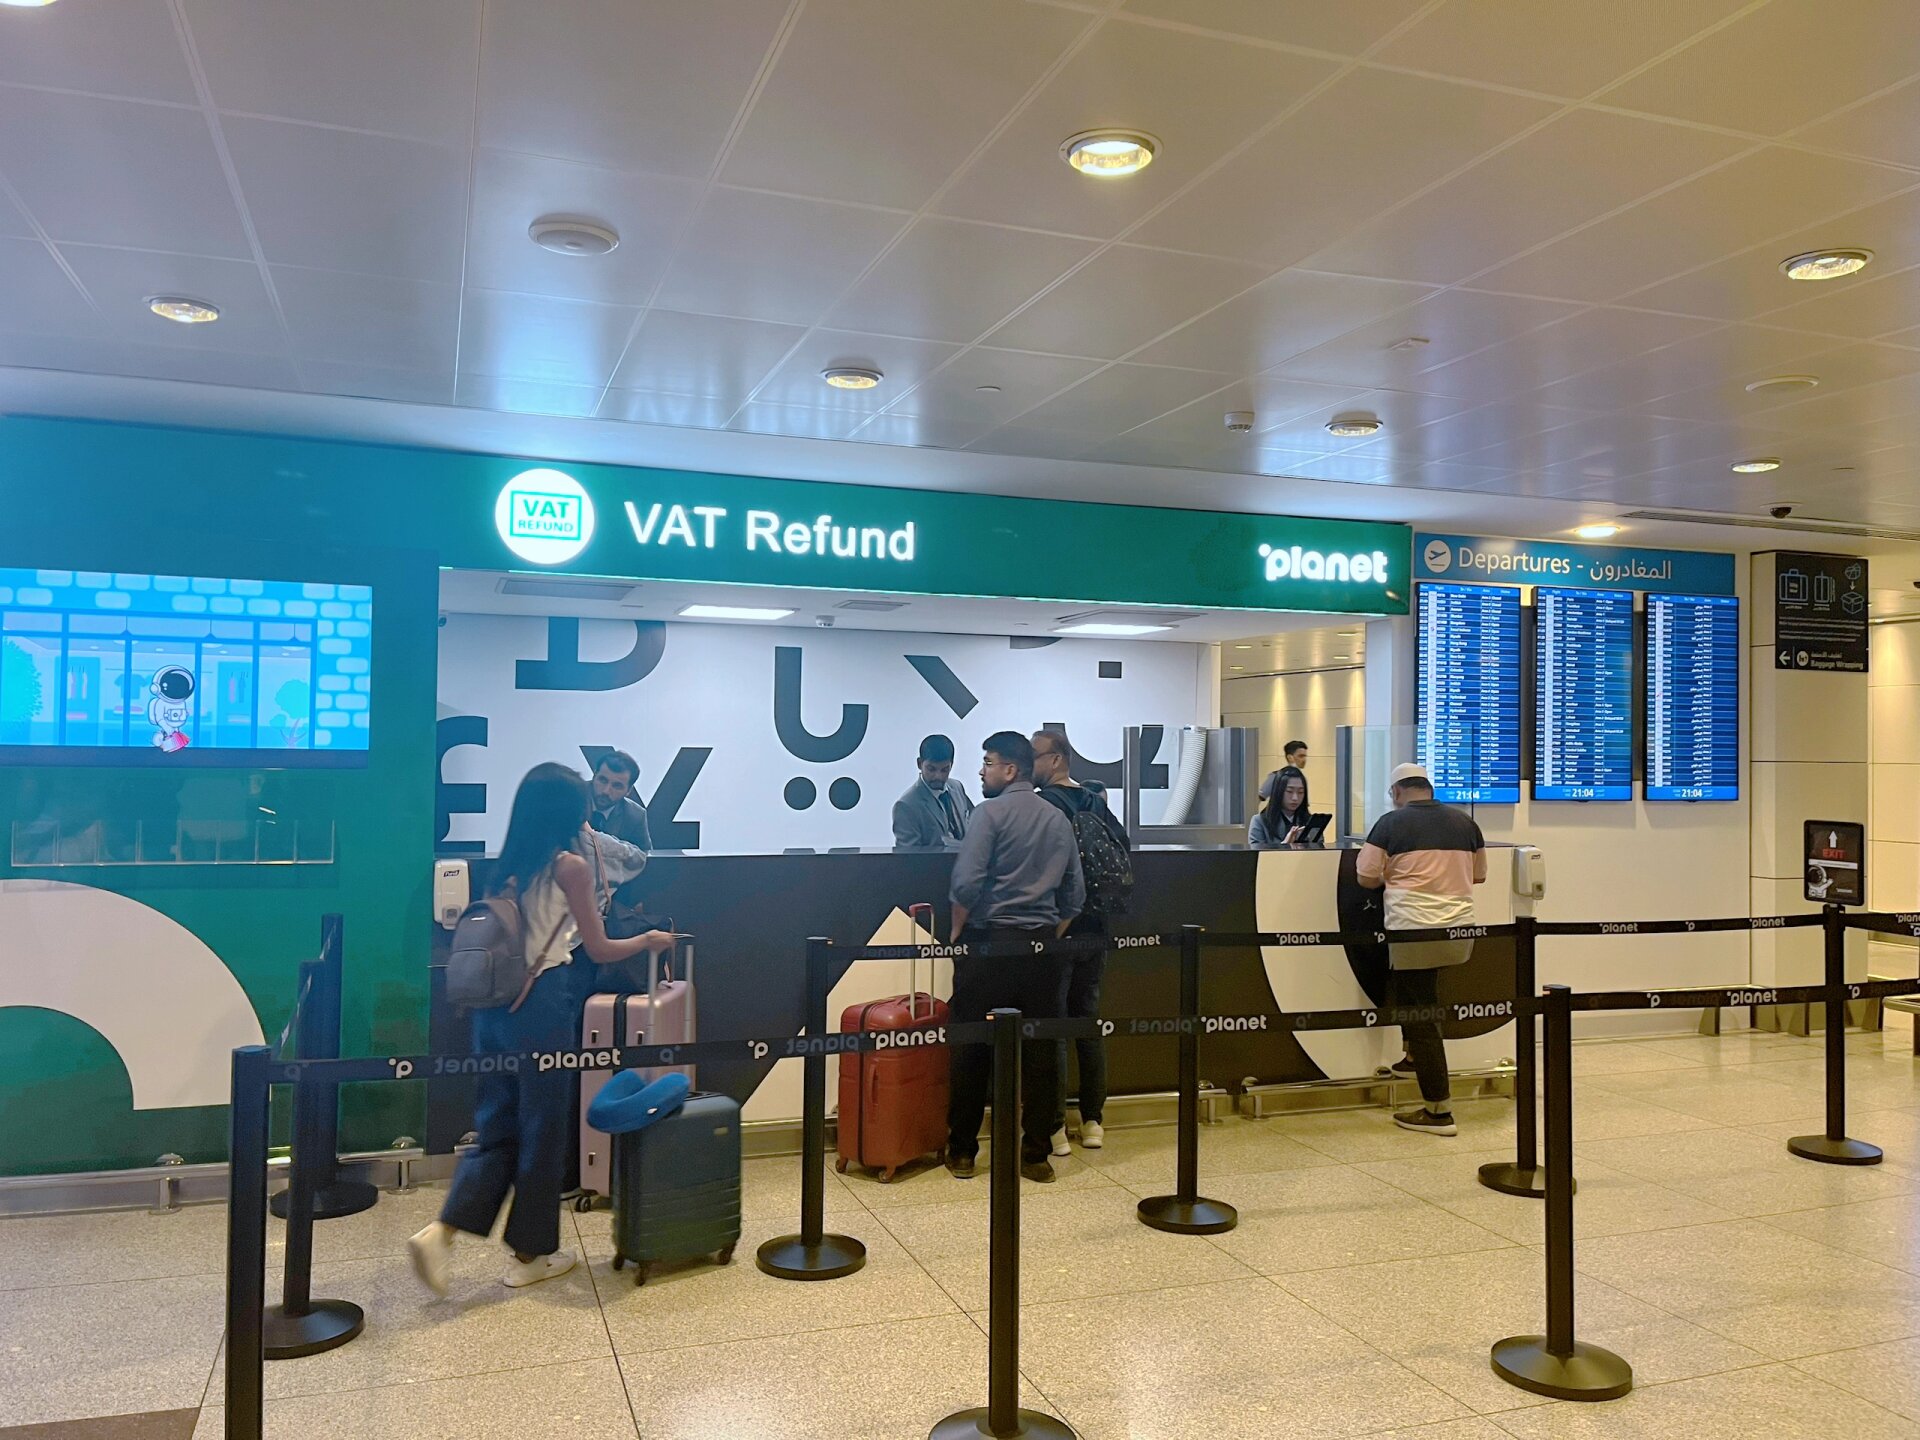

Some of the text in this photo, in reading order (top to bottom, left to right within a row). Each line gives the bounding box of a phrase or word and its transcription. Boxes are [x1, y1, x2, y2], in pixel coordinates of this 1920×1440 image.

[523, 499, 570, 518] VAT
[518, 519, 574, 532] REFUND
[624, 501, 916, 561] VAT Refund
[1259, 544, 1388, 583] planet
[1459, 547, 1570, 574] Departures
[1590, 558, 1672, 581] المغادرون
[1456, 790, 1480, 800] 21:04
[1572, 788, 1594, 798] 21:04
[1681, 788, 1703, 798] 21:04
[1823, 848, 1846, 859] EXIT
[1600, 922, 1638, 934] planet
[1749, 916, 1785, 928] planet
[1276, 933, 1320, 945] planet
[1446, 926, 1487, 940] planet
[1114, 934, 1161, 949] planet
[917, 943, 968, 958] planet
[1726, 989, 1777, 1006] planet
[1453, 1001, 1512, 1020] planet
[1201, 1014, 1267, 1033] planet
[869, 1027, 946, 1051] planet
[532, 1048, 621, 1072] planet
